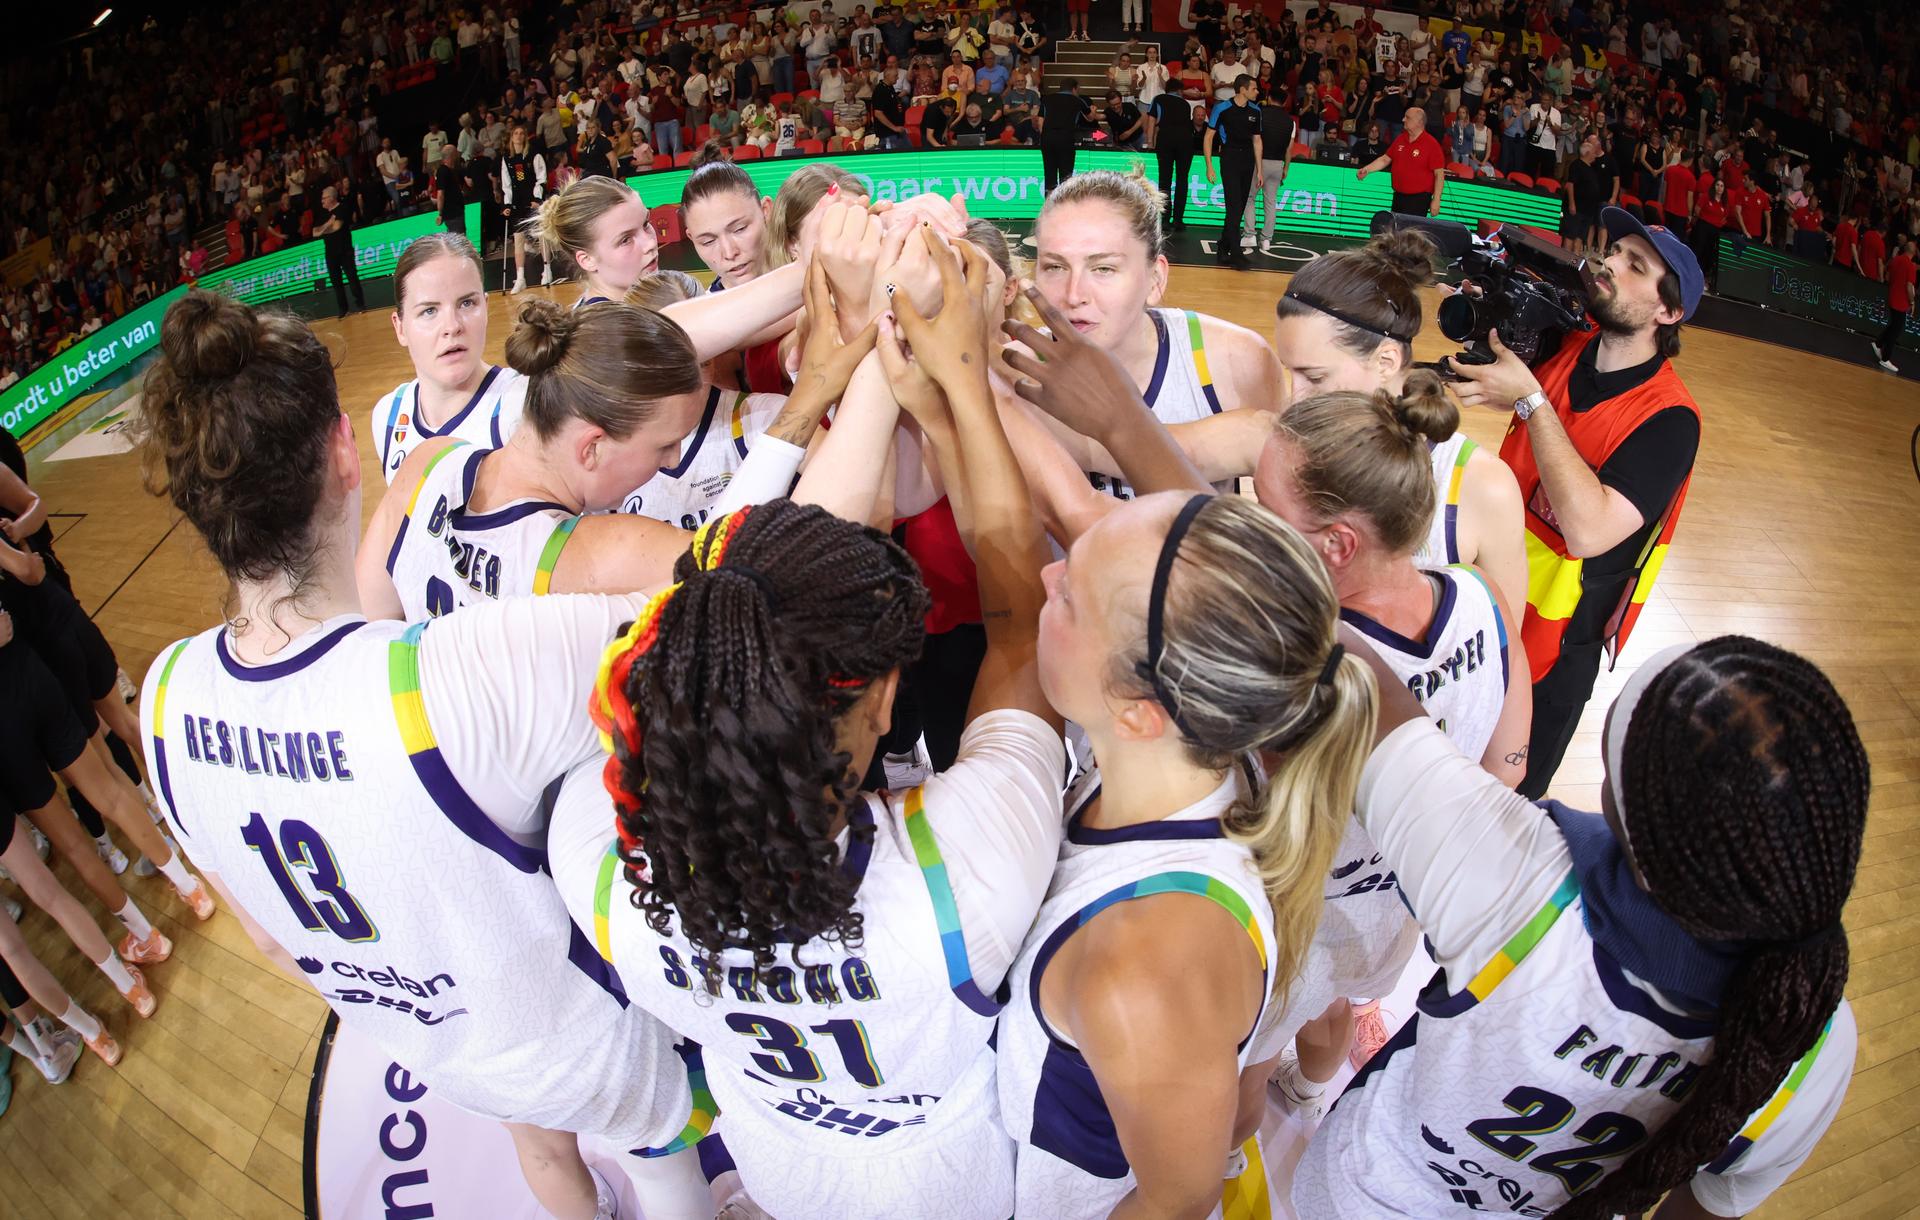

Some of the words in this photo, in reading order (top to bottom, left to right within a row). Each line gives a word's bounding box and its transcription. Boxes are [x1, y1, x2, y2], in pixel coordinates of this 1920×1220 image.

[783, 124, 795, 138] 26
[953, 174, 1046, 202] wor
[262, 255, 313, 288] wordt
[1771, 266, 1825, 305] Daar
[0, 386, 49, 431] ordt
[49, 376, 64, 397] u
[63, 339, 119, 387] beter
[121, 320, 156, 350] van
[690, 475, 721, 489] foundation
[702, 481, 722, 492] against
[184, 714, 354, 783] RESLIENCE
[240, 812, 381, 944] 13
[331, 961, 457, 999] crelan
[659, 944, 881, 1004] STRONG
[334, 988, 446, 1026] DHL
[725, 1012, 885, 1089] 31
[1465, 1085, 1648, 1197] 22
